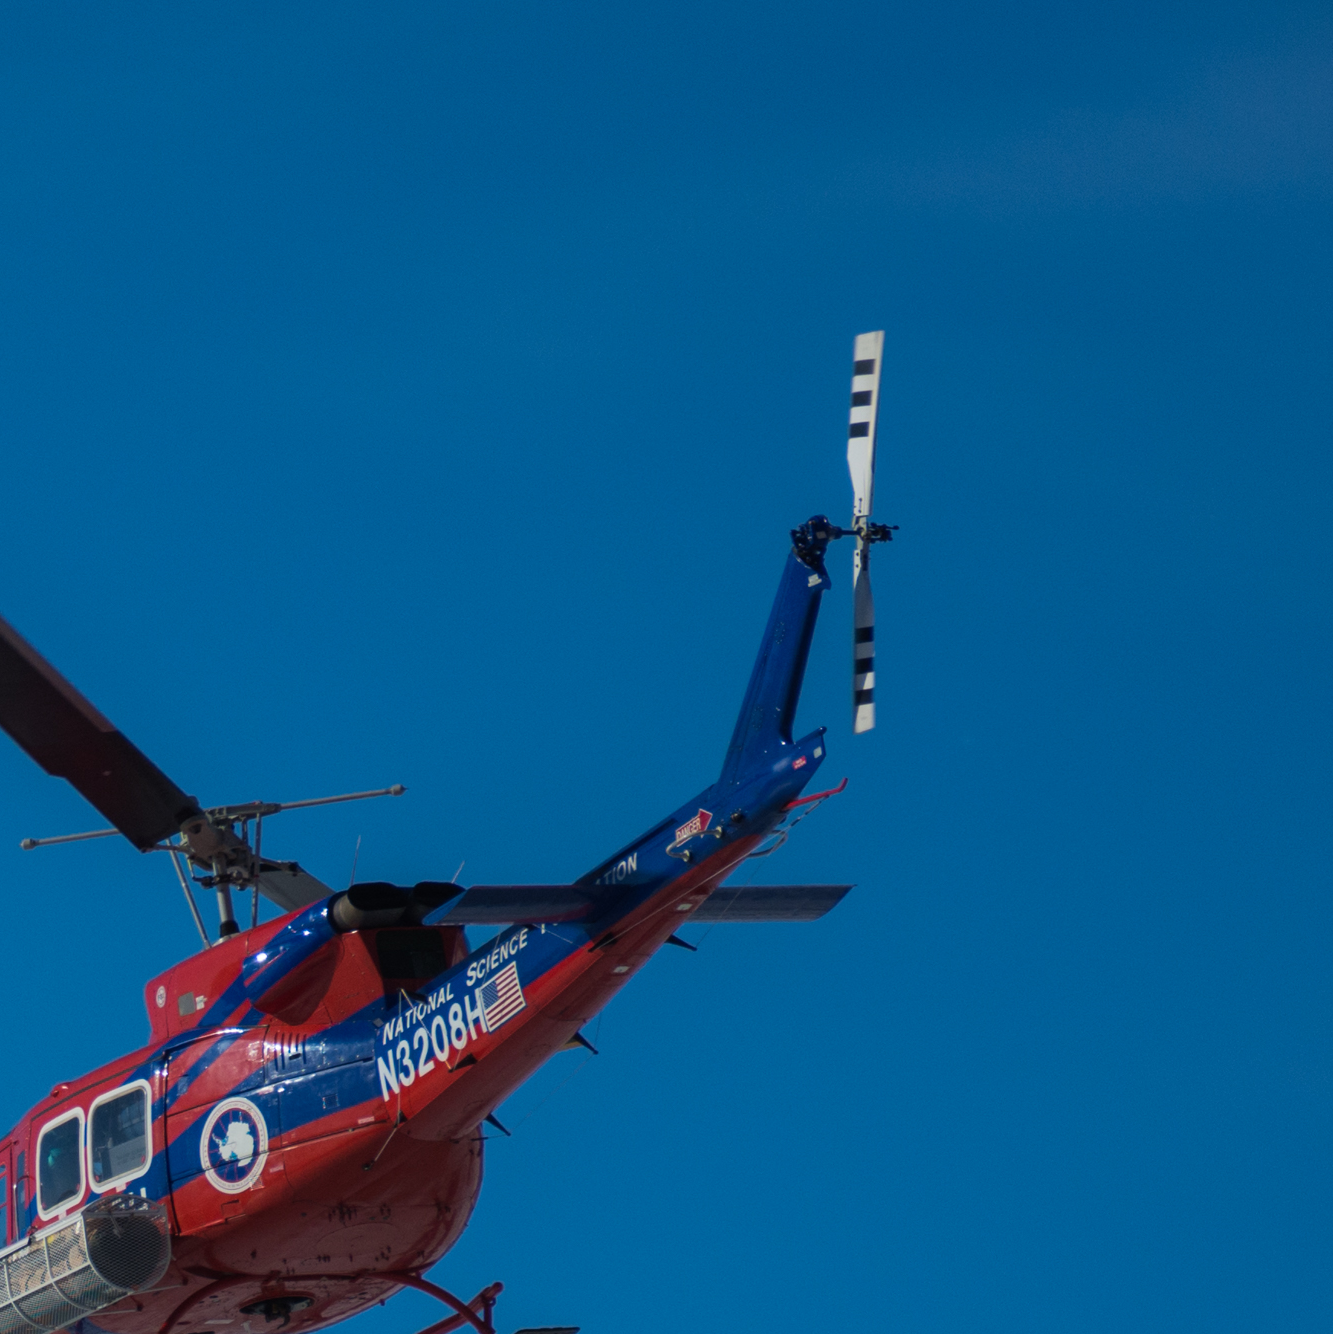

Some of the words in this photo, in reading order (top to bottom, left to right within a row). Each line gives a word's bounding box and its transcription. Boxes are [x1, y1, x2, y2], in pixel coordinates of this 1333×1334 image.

[676, 817, 701, 841] DANGER
[383, 983, 454, 1045] NATIONAL
[466, 928, 529, 986] SCIENCE
[377, 987, 487, 1102] N3208H
